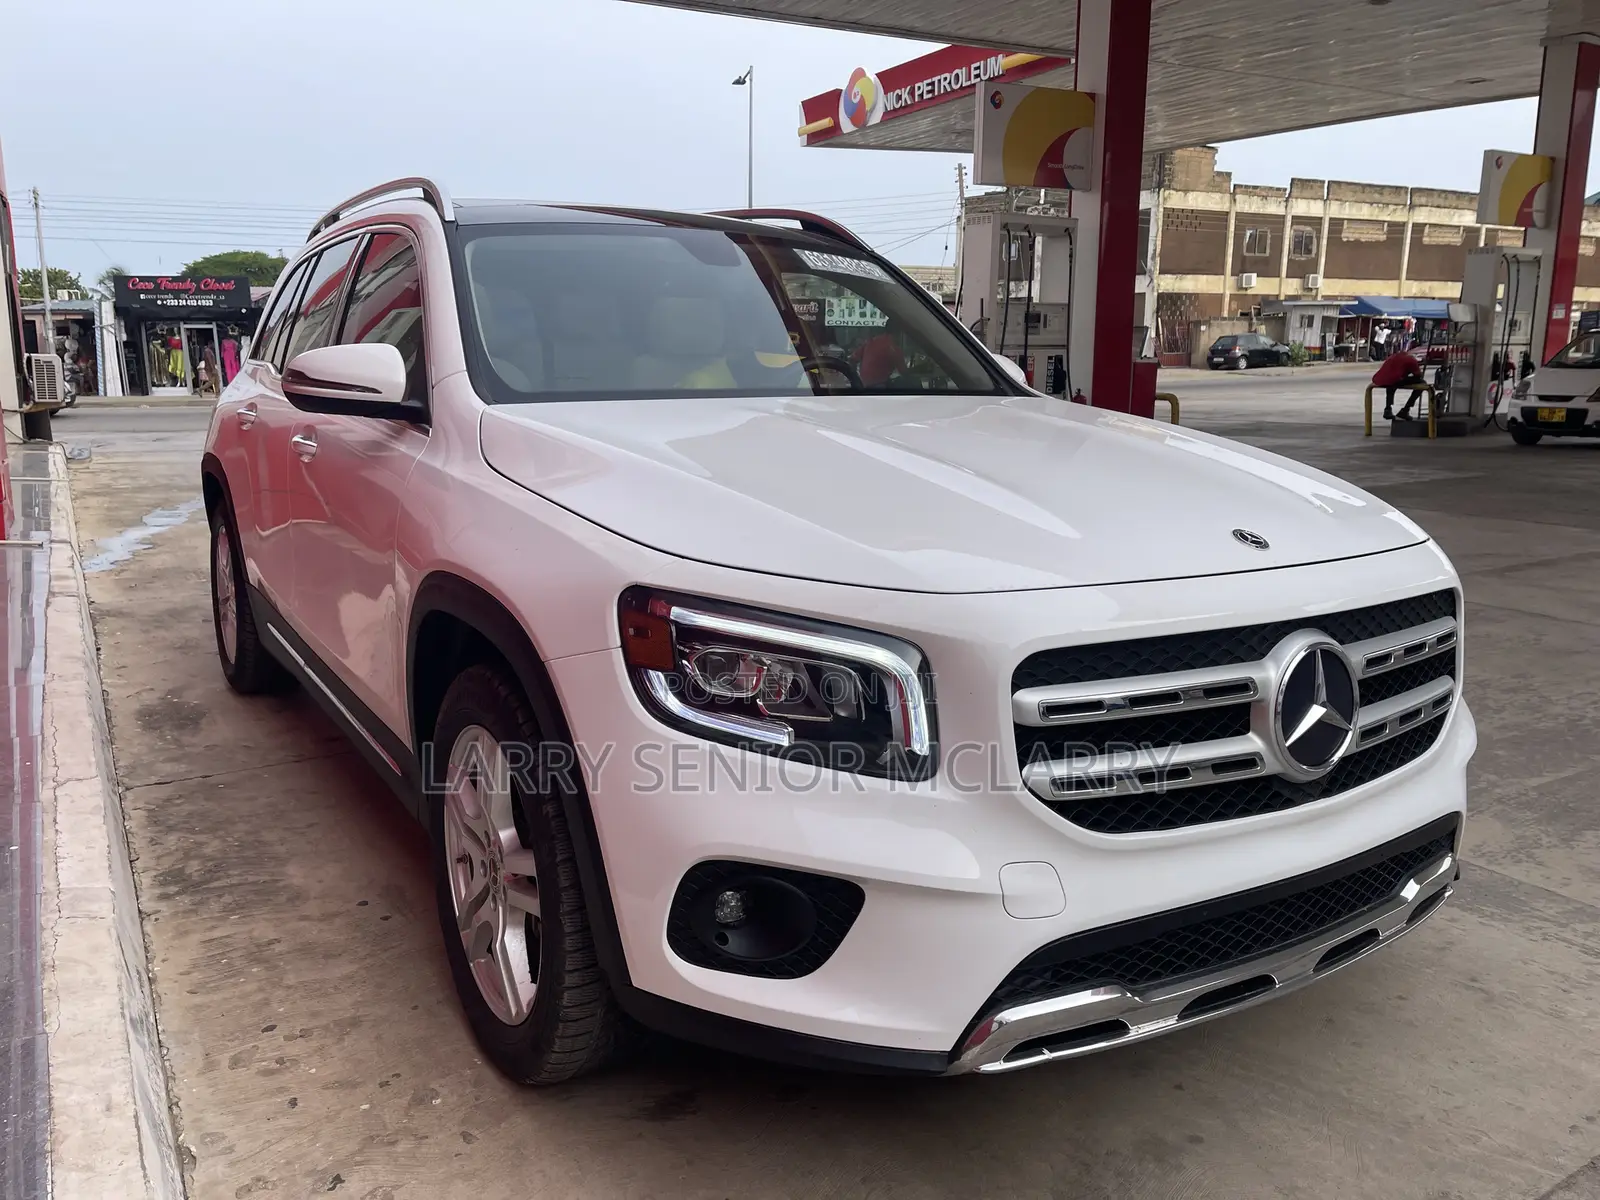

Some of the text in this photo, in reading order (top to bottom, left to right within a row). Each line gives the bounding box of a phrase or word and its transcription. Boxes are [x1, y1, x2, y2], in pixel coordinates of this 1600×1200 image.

[884, 54, 1004, 111] NICK PETROLEUM
[157, 277, 197, 295] Trendy
[200, 277, 236, 291] Closet
[1046, 356, 1055, 393] DIESEL
